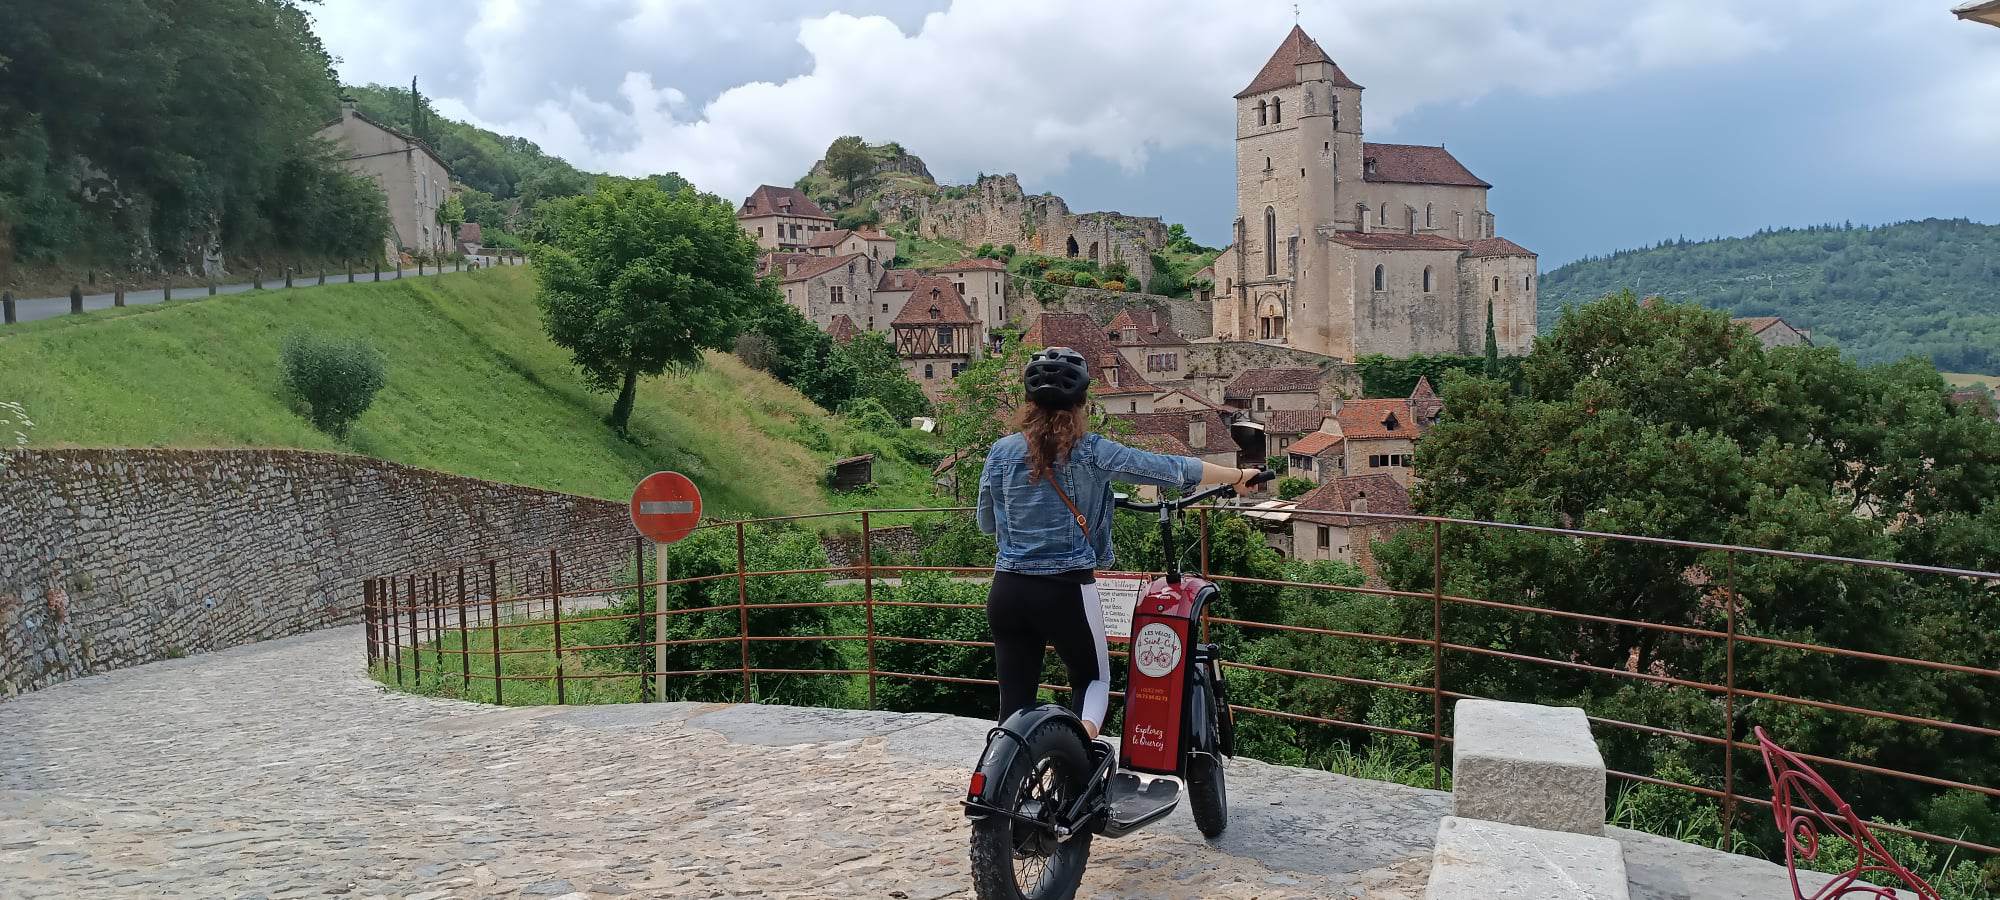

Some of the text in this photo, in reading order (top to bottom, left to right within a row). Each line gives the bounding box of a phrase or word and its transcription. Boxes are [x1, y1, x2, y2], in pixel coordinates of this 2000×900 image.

[1112, 580, 1136, 589] Village
[1136, 724, 1163, 740] Explorez
[1133, 735, 1164, 752] le Quercy
